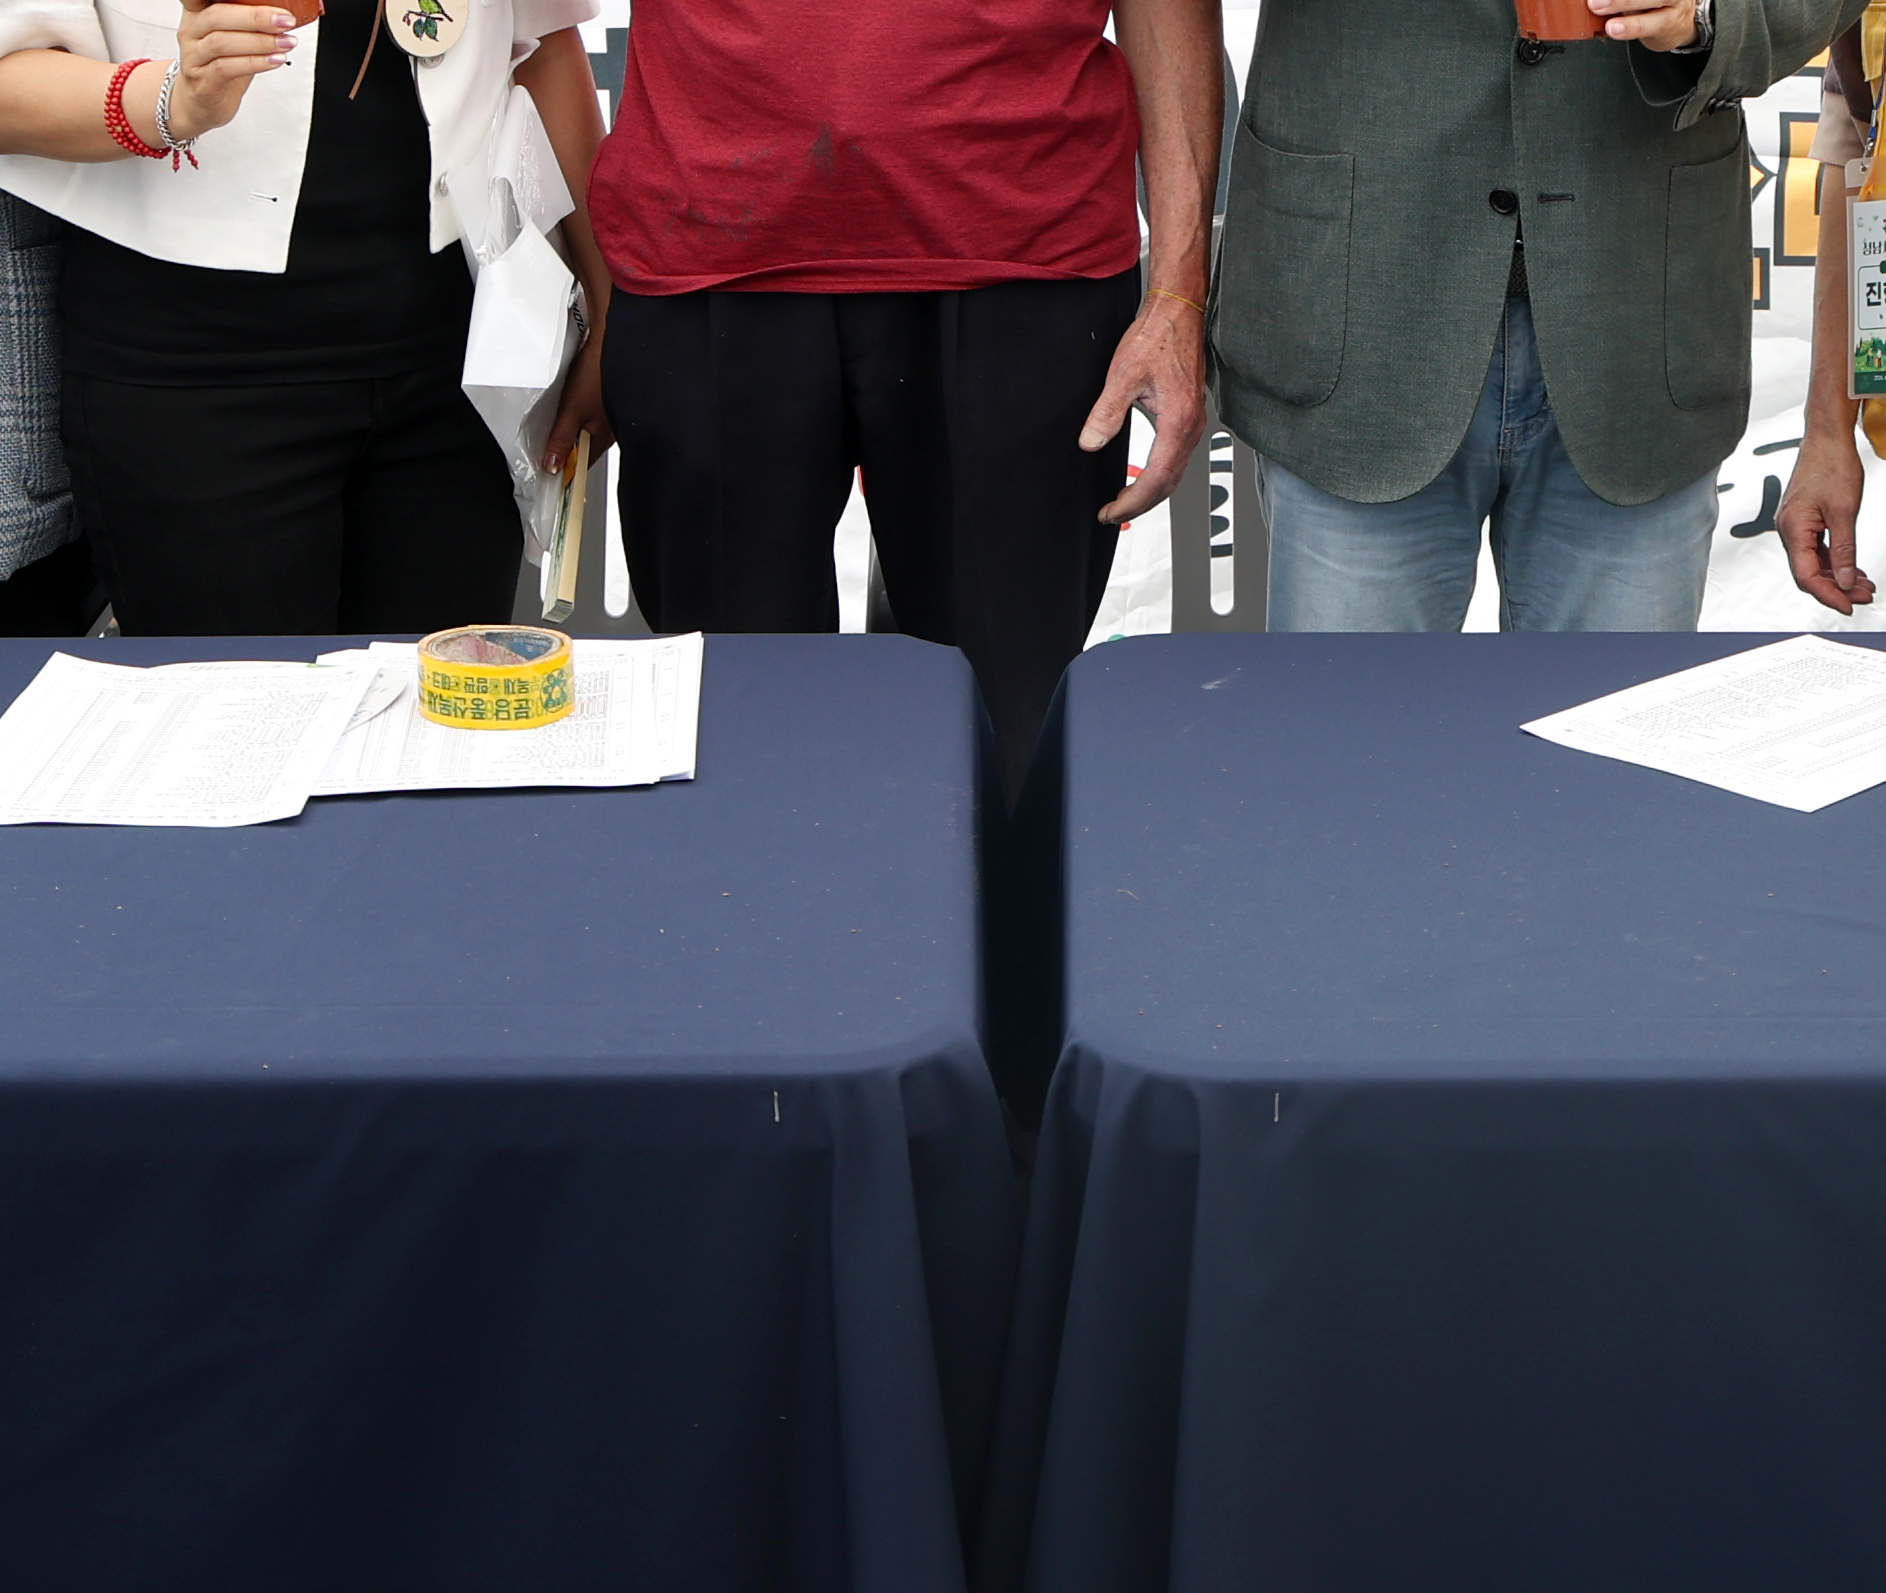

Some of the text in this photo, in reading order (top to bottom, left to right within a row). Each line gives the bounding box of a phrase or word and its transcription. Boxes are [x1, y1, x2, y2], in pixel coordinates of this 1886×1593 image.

[463, 676, 489, 695] 합판
[504, 678, 530, 695] 목재
[495, 699, 531, 721] 분당
